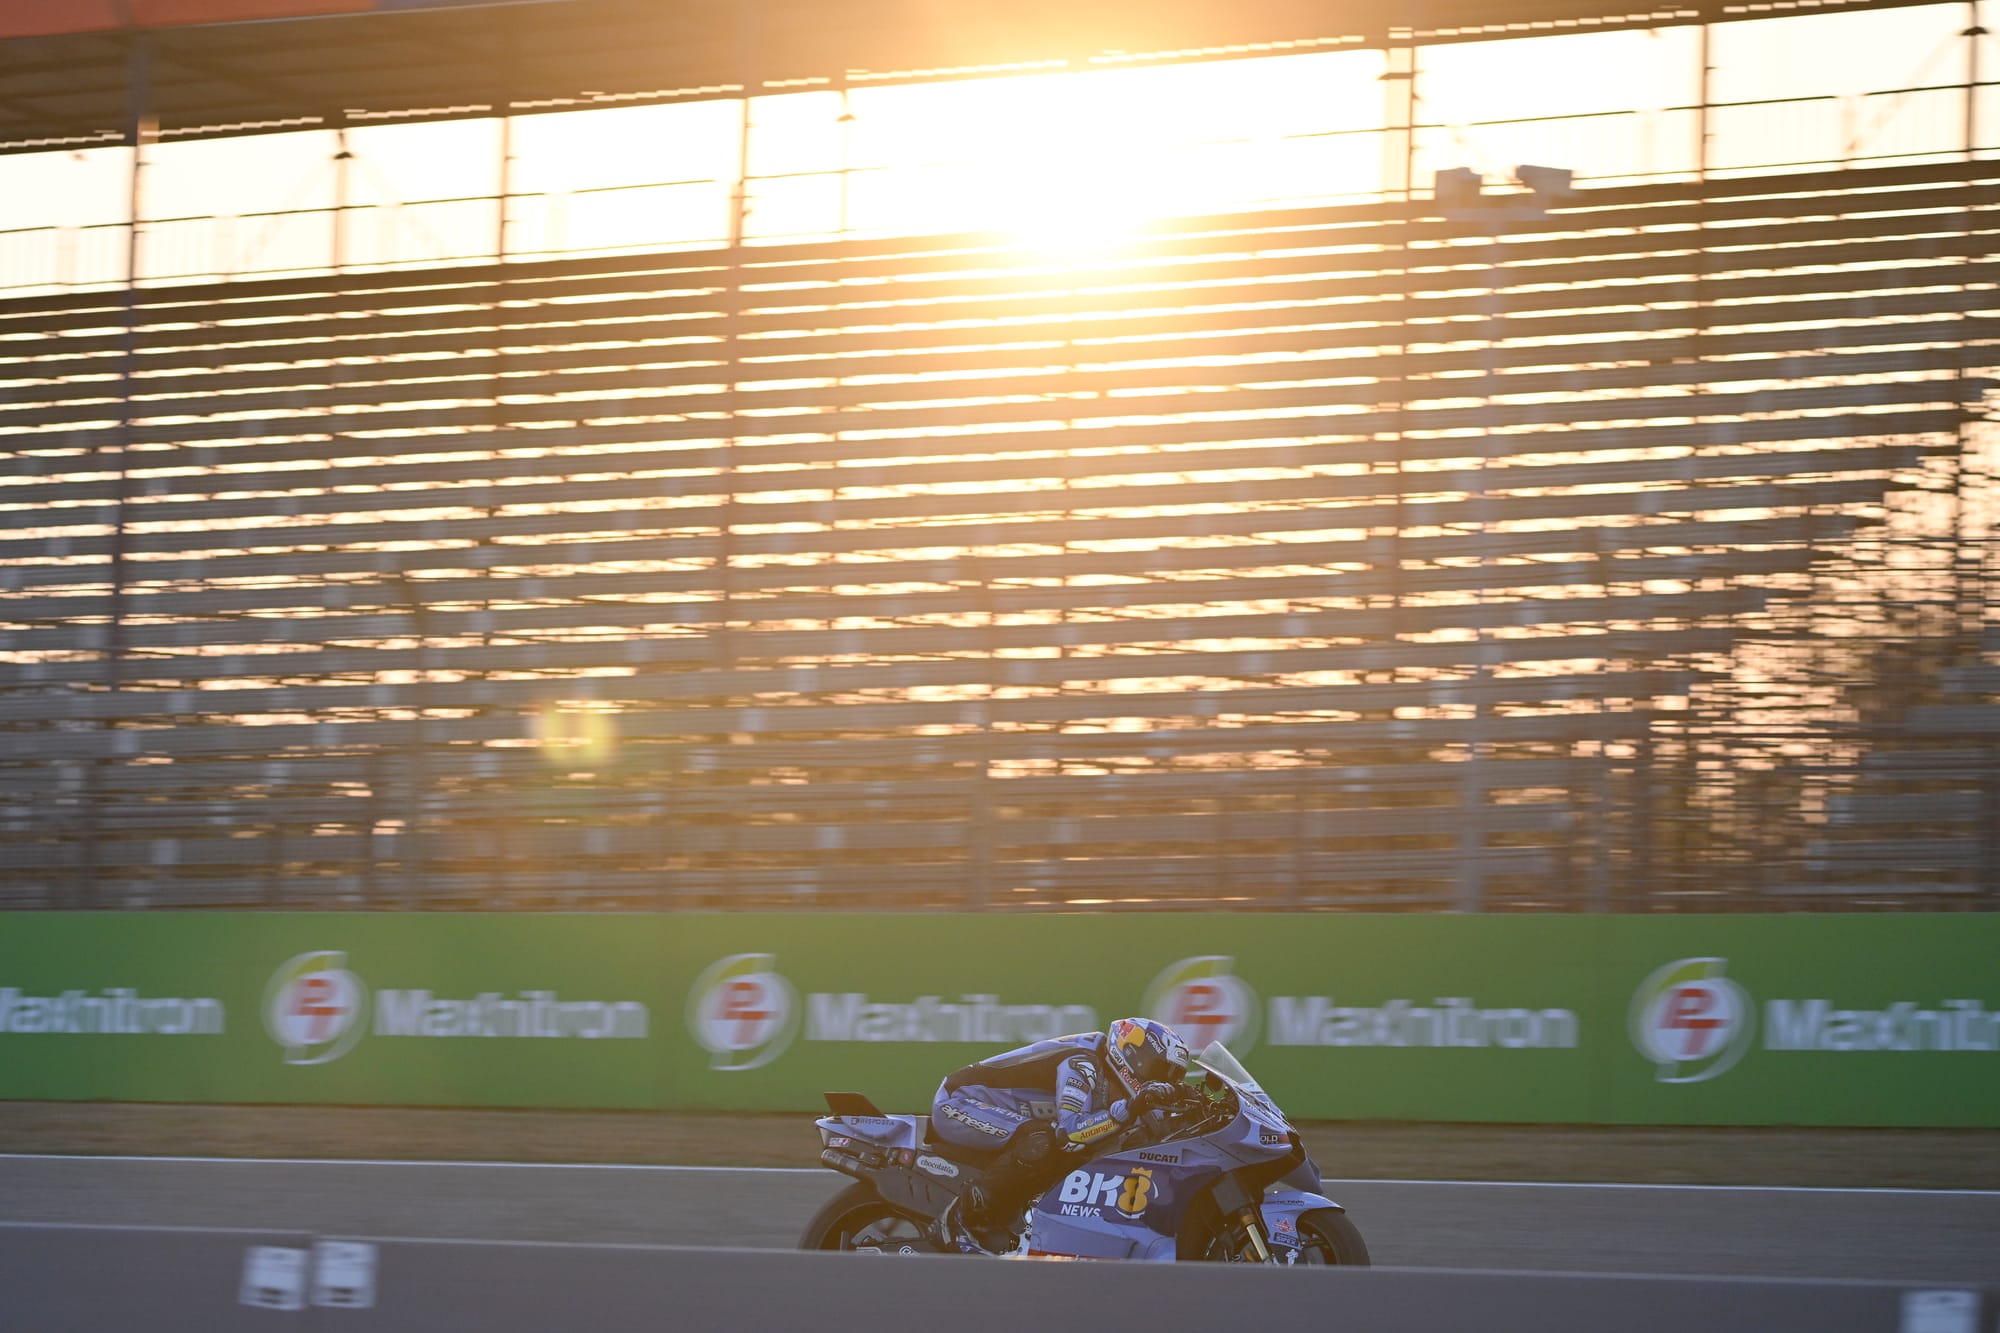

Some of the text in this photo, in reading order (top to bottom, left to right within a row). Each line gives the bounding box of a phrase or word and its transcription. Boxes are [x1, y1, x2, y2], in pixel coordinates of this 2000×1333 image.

[941, 1104, 1009, 1138] alpinestars
[1139, 1152, 1178, 1164] DUCATI
[1060, 1204, 1101, 1218] NEWS
